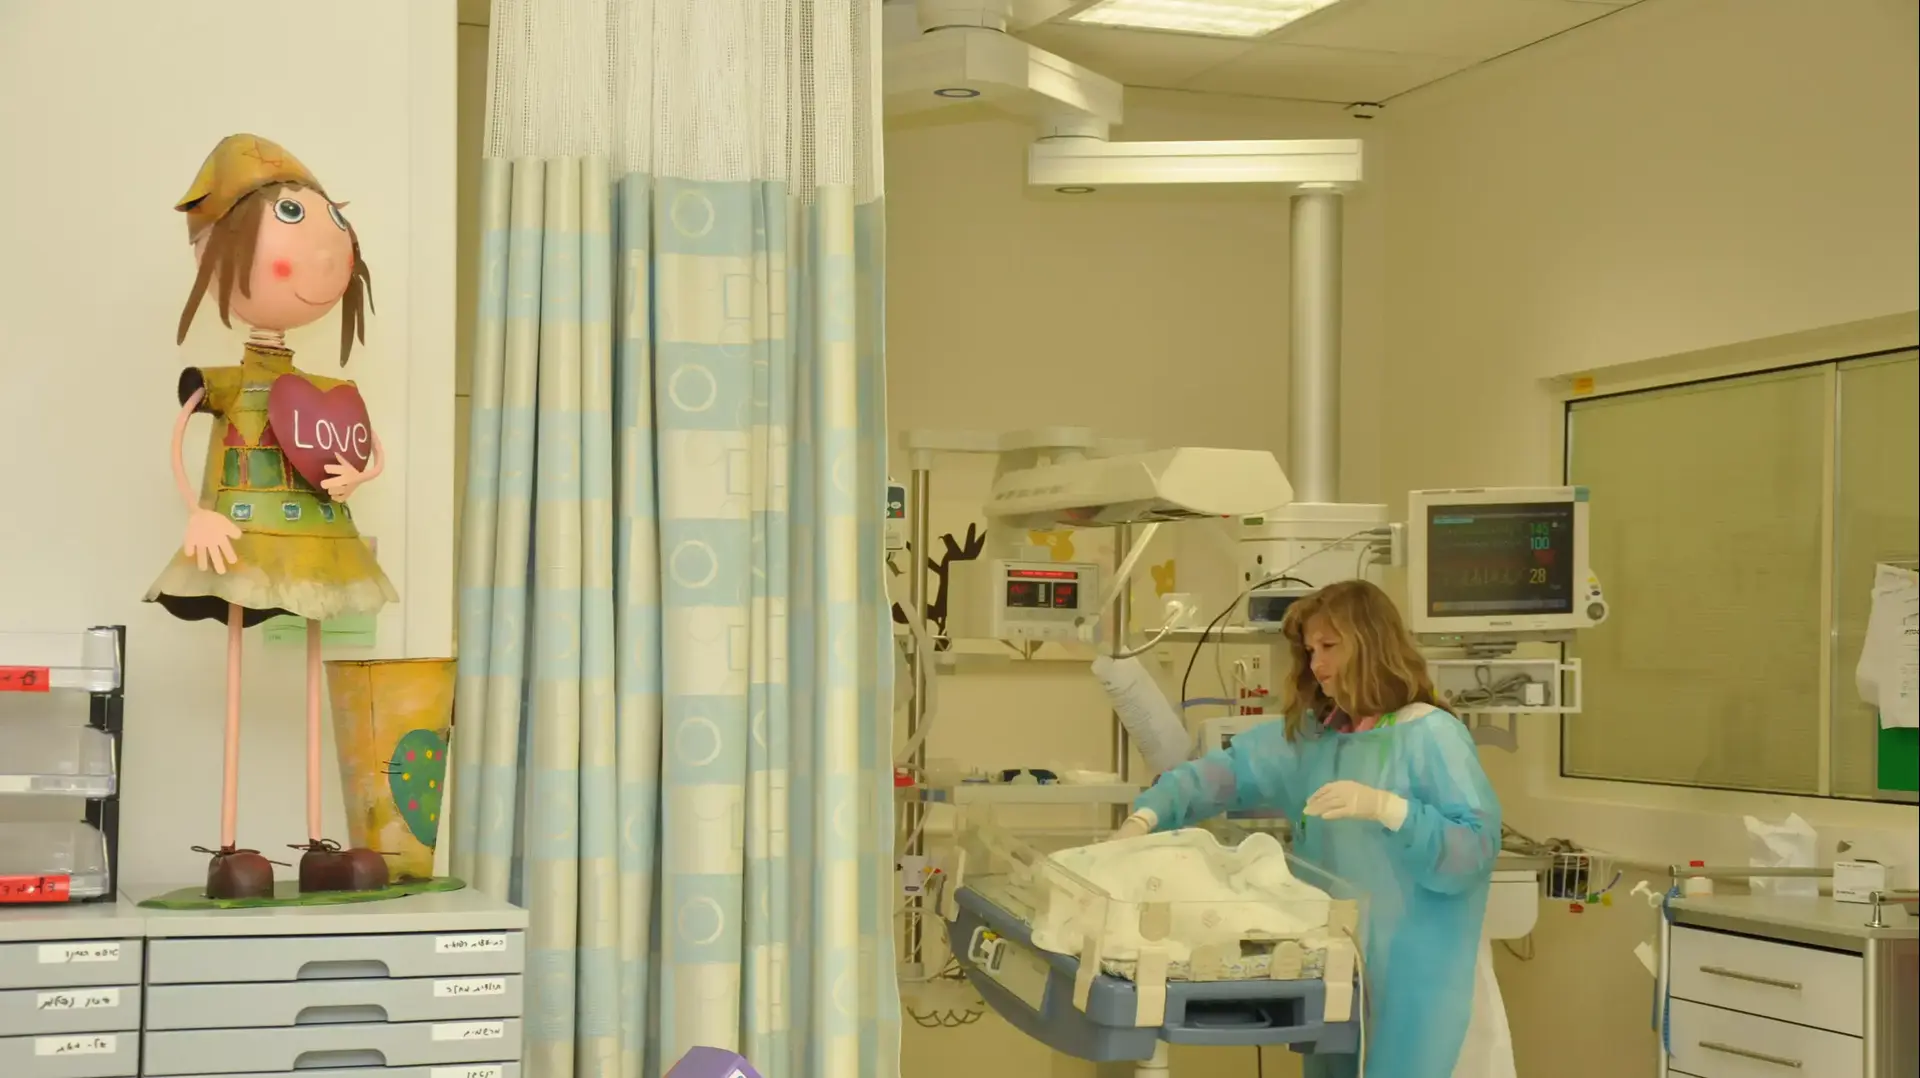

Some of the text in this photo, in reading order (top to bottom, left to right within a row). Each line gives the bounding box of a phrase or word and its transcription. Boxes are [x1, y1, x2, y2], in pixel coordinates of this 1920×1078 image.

[294, 410, 368, 460] Love
[1530, 536, 1550, 550] 100
[1529, 567, 1546, 584] 28
